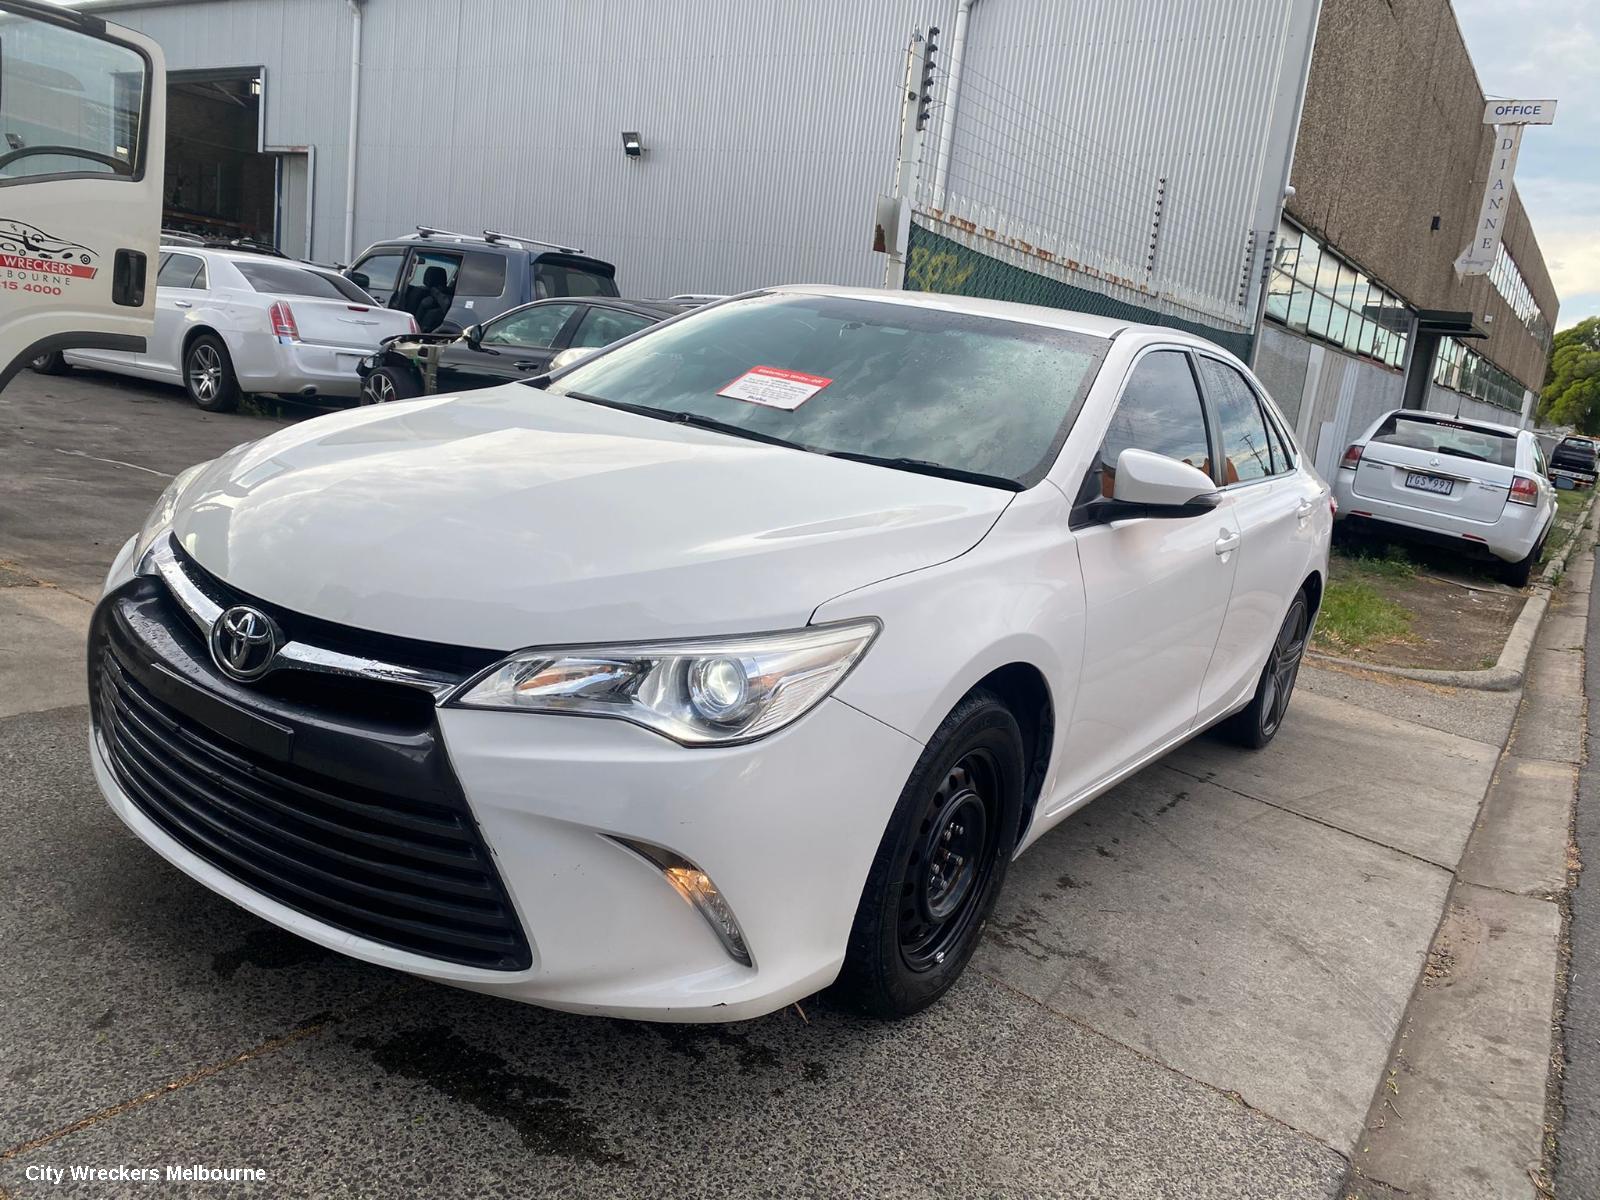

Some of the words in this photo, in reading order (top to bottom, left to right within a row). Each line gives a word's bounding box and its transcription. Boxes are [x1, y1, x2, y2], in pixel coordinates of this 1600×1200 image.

[1495, 105, 1541, 115] OFFICE
[1482, 138, 1513, 249] DIANNE
[2, 255, 73, 275] WRECKERS
[0, 268, 71, 286] BOURNE
[23, 283, 62, 296] 4000
